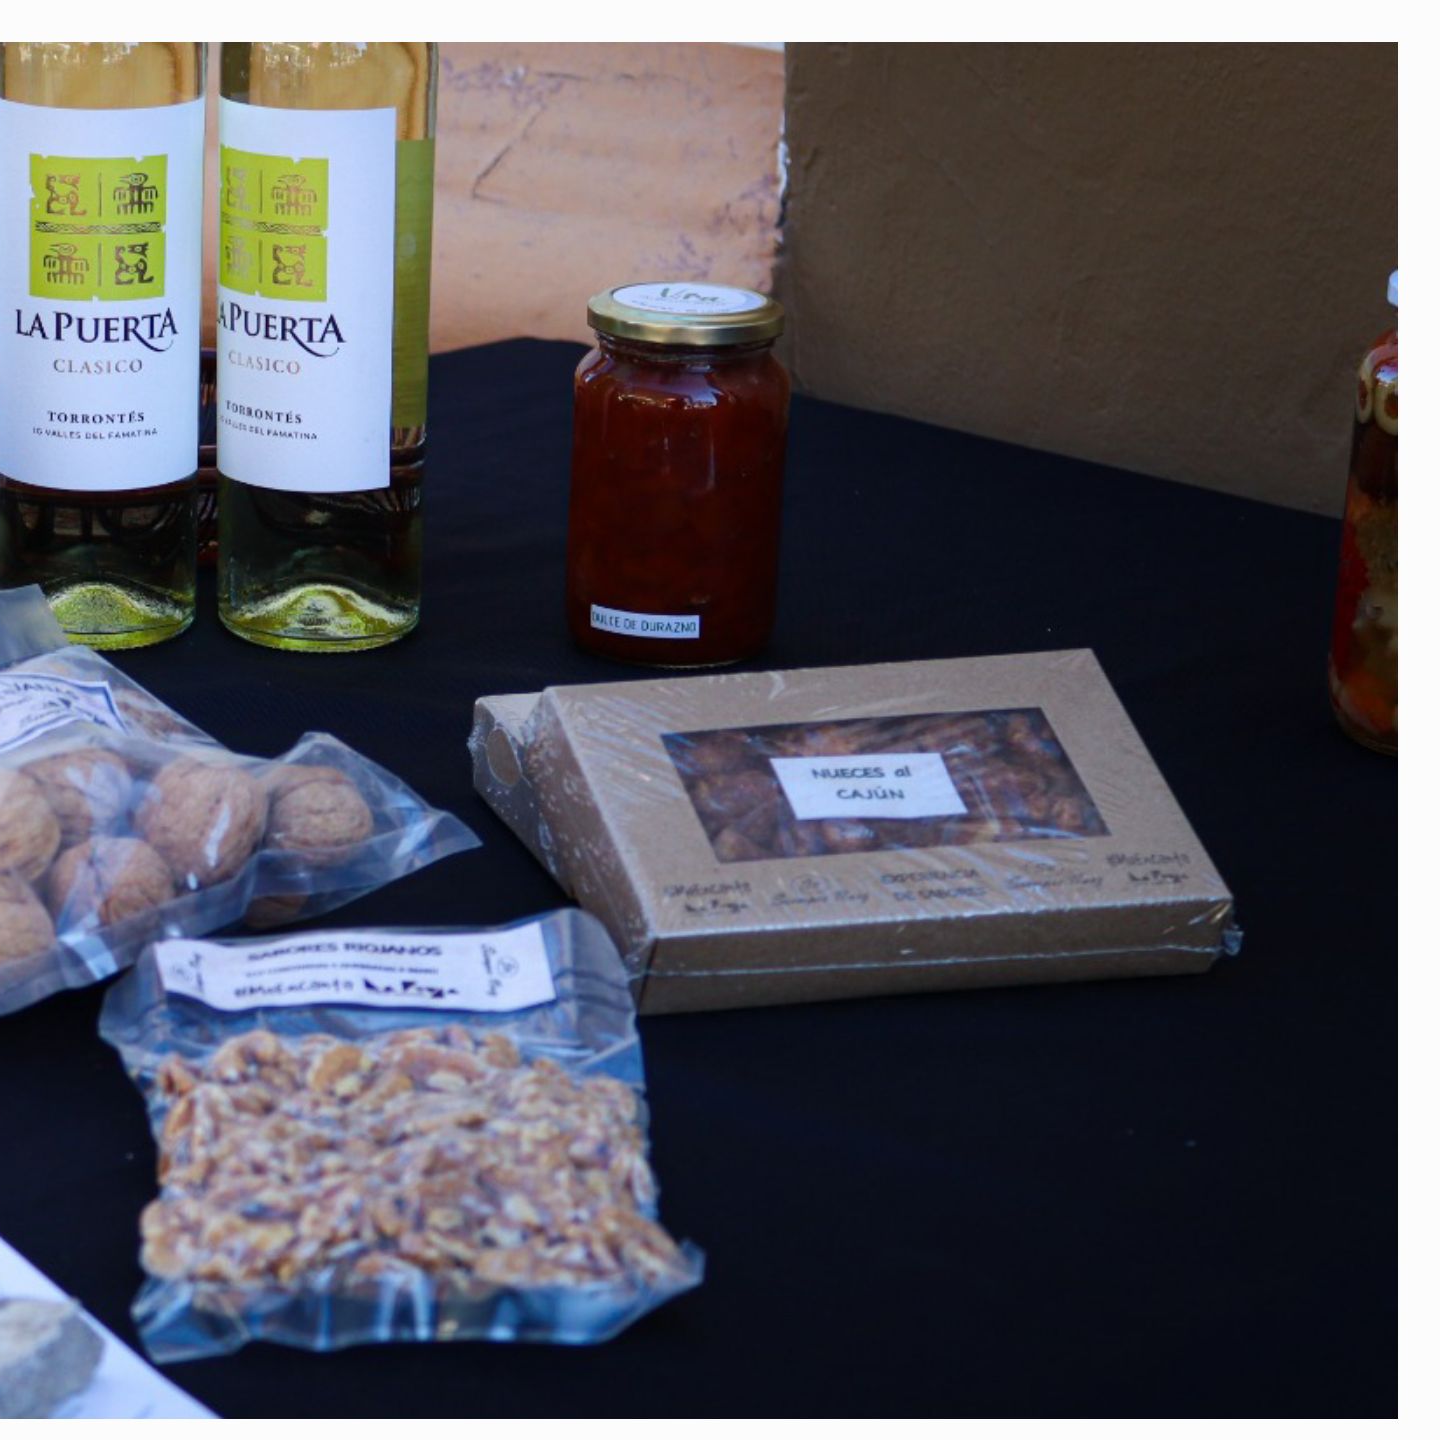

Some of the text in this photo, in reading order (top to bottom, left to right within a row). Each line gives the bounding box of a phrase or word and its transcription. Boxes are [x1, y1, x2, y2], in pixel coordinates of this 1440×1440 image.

[15, 306, 179, 352] LA PUERTA
[229, 301, 347, 358] PUERTA
[53, 358, 143, 375] CLASICO
[228, 349, 301, 376] CLASICO
[47, 409, 146, 425] TORRONTÉS
[225, 399, 303, 425] TORRONTÉS
[45, 428, 82, 440] VALLES
[85, 431, 106, 441] DEL
[108, 427, 159, 440] FAMATINA
[623, 618, 637, 630] DE
[640, 619, 697, 634] DURAZNO
[811, 765, 913, 780] NUECES al
[835, 785, 906, 801] CAJÚN
